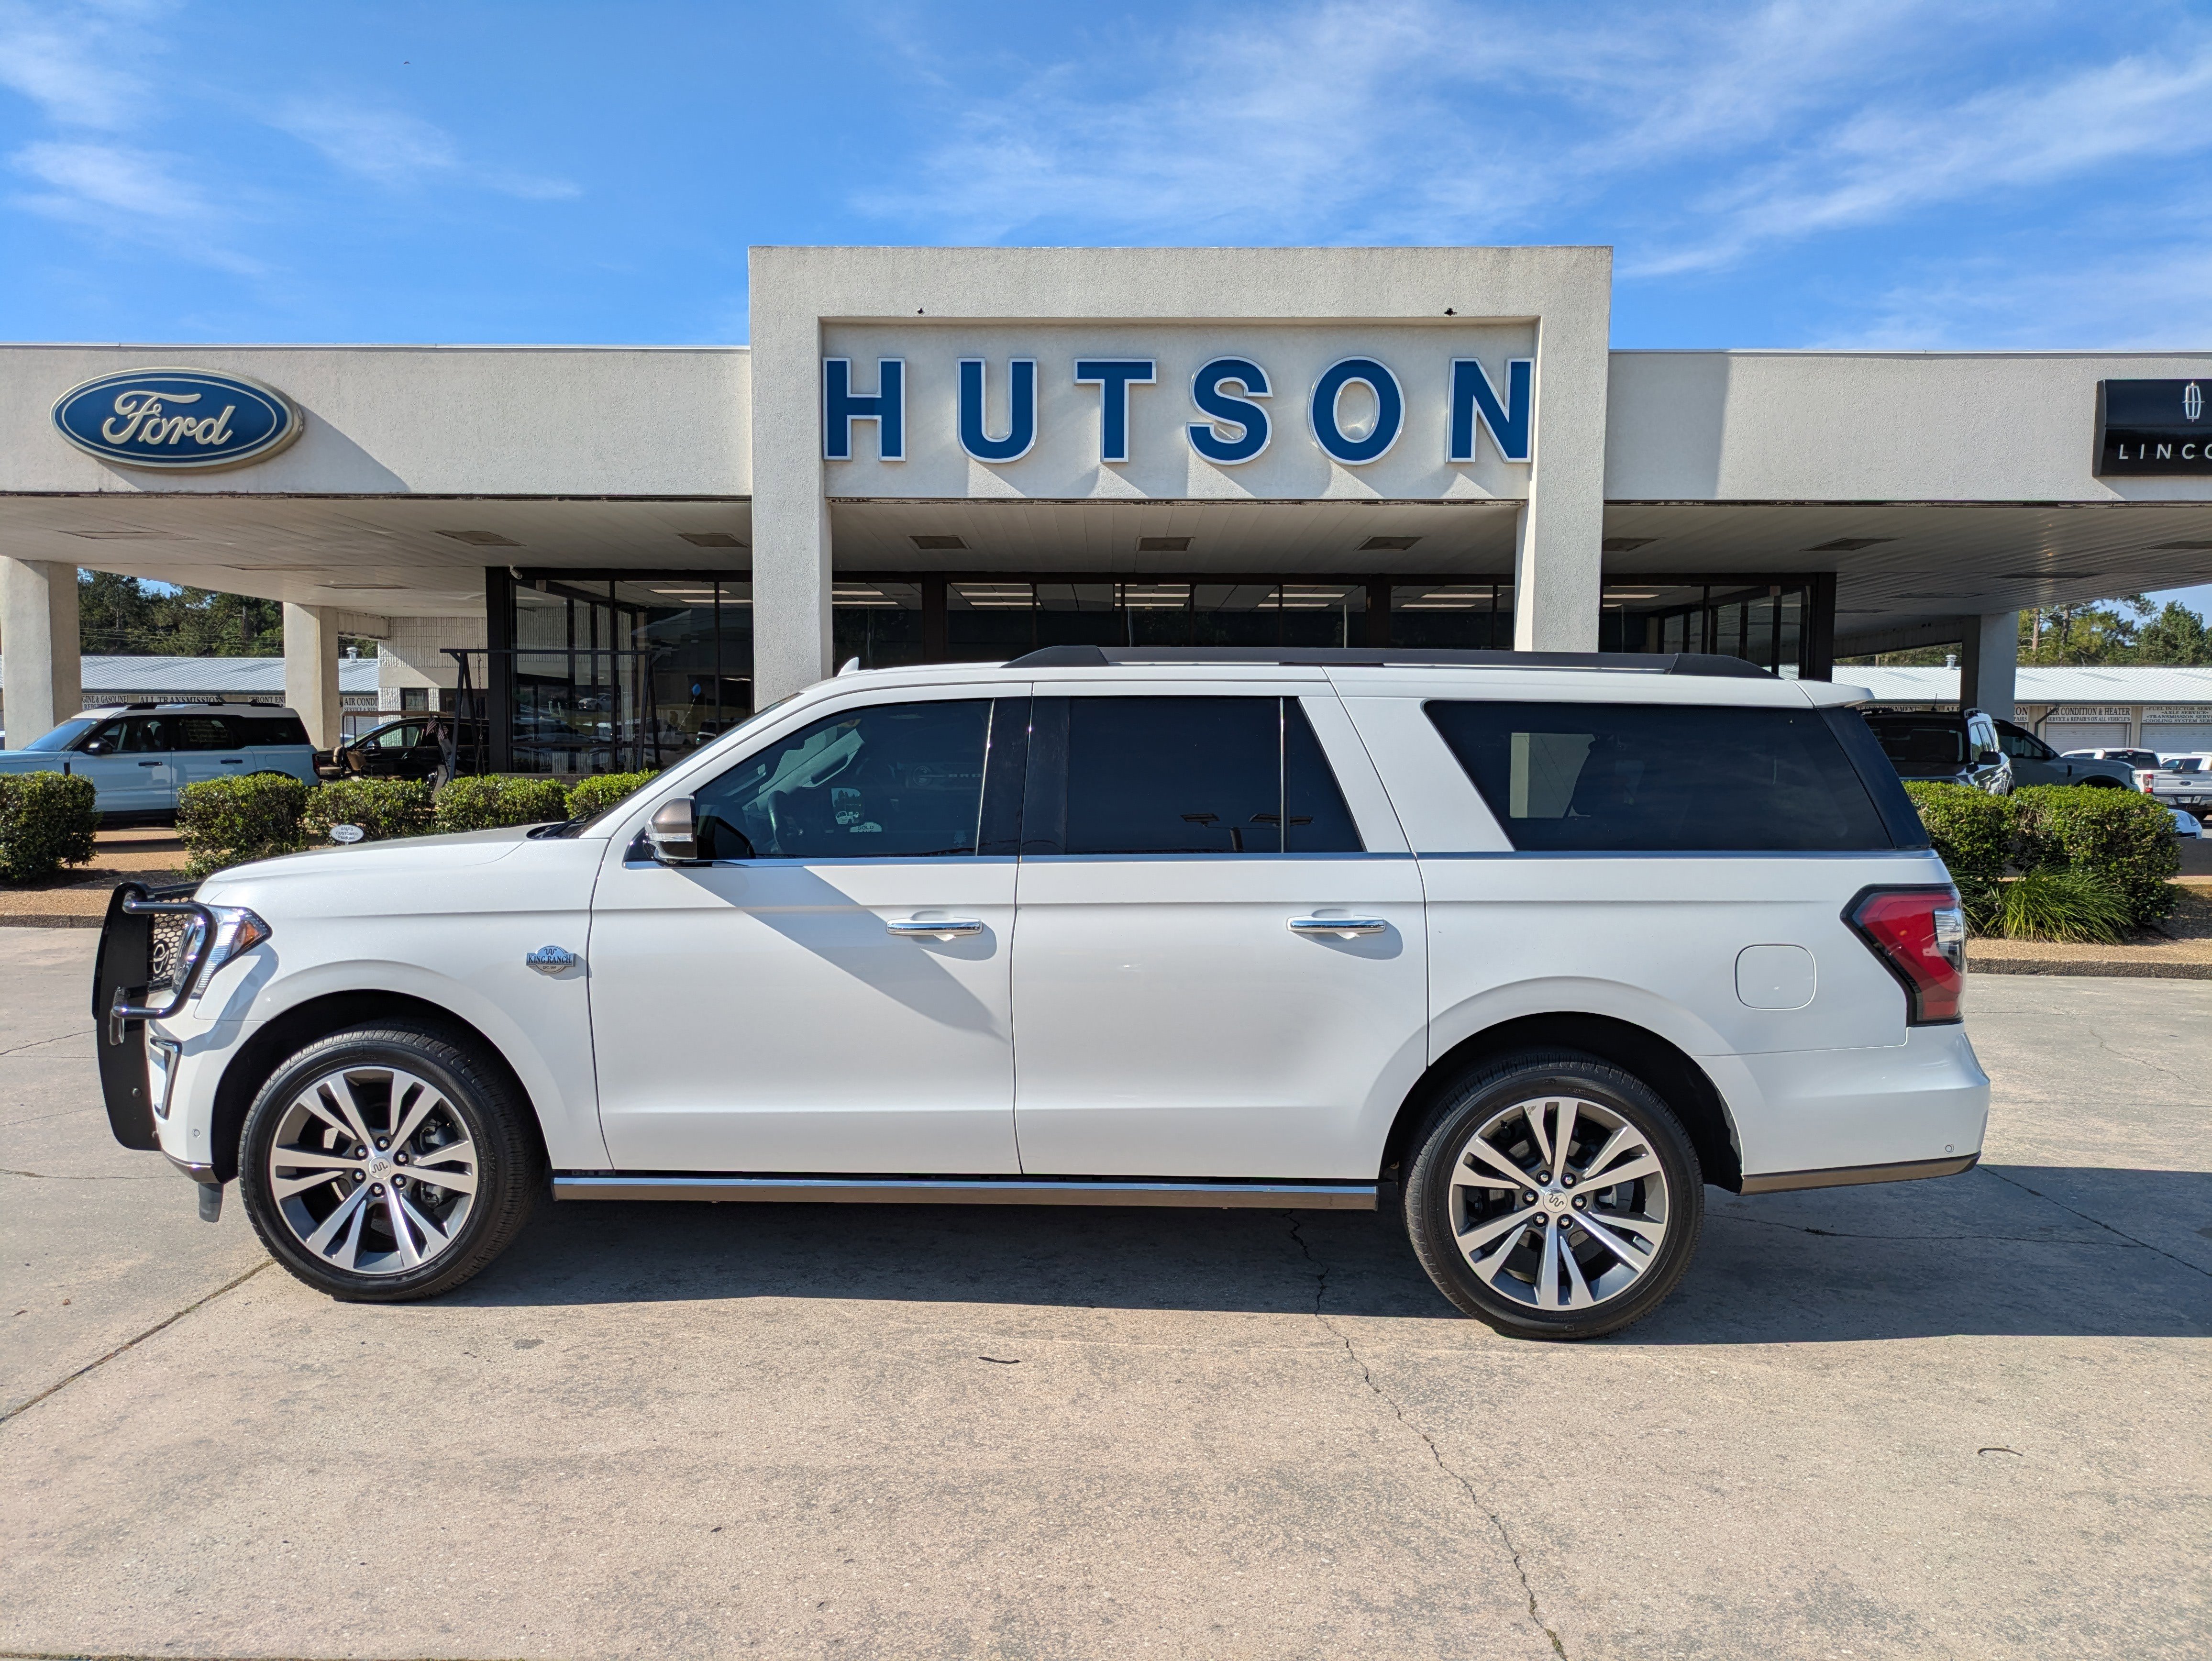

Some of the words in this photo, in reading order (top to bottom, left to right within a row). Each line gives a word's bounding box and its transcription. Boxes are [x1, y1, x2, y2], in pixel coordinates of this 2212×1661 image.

[822, 355, 1535, 465] HUTSON
[102, 390, 236, 445] Ford
[101, 695, 127, 703] GASOLINE
[344, 698, 355, 706] AIR
[2061, 707, 2097, 716] CONDITION
[2098, 707, 2103, 716] &
[2104, 707, 2131, 716] HEATER
[528, 955, 546, 963] KING
[547, 955, 571, 963] RANCH
